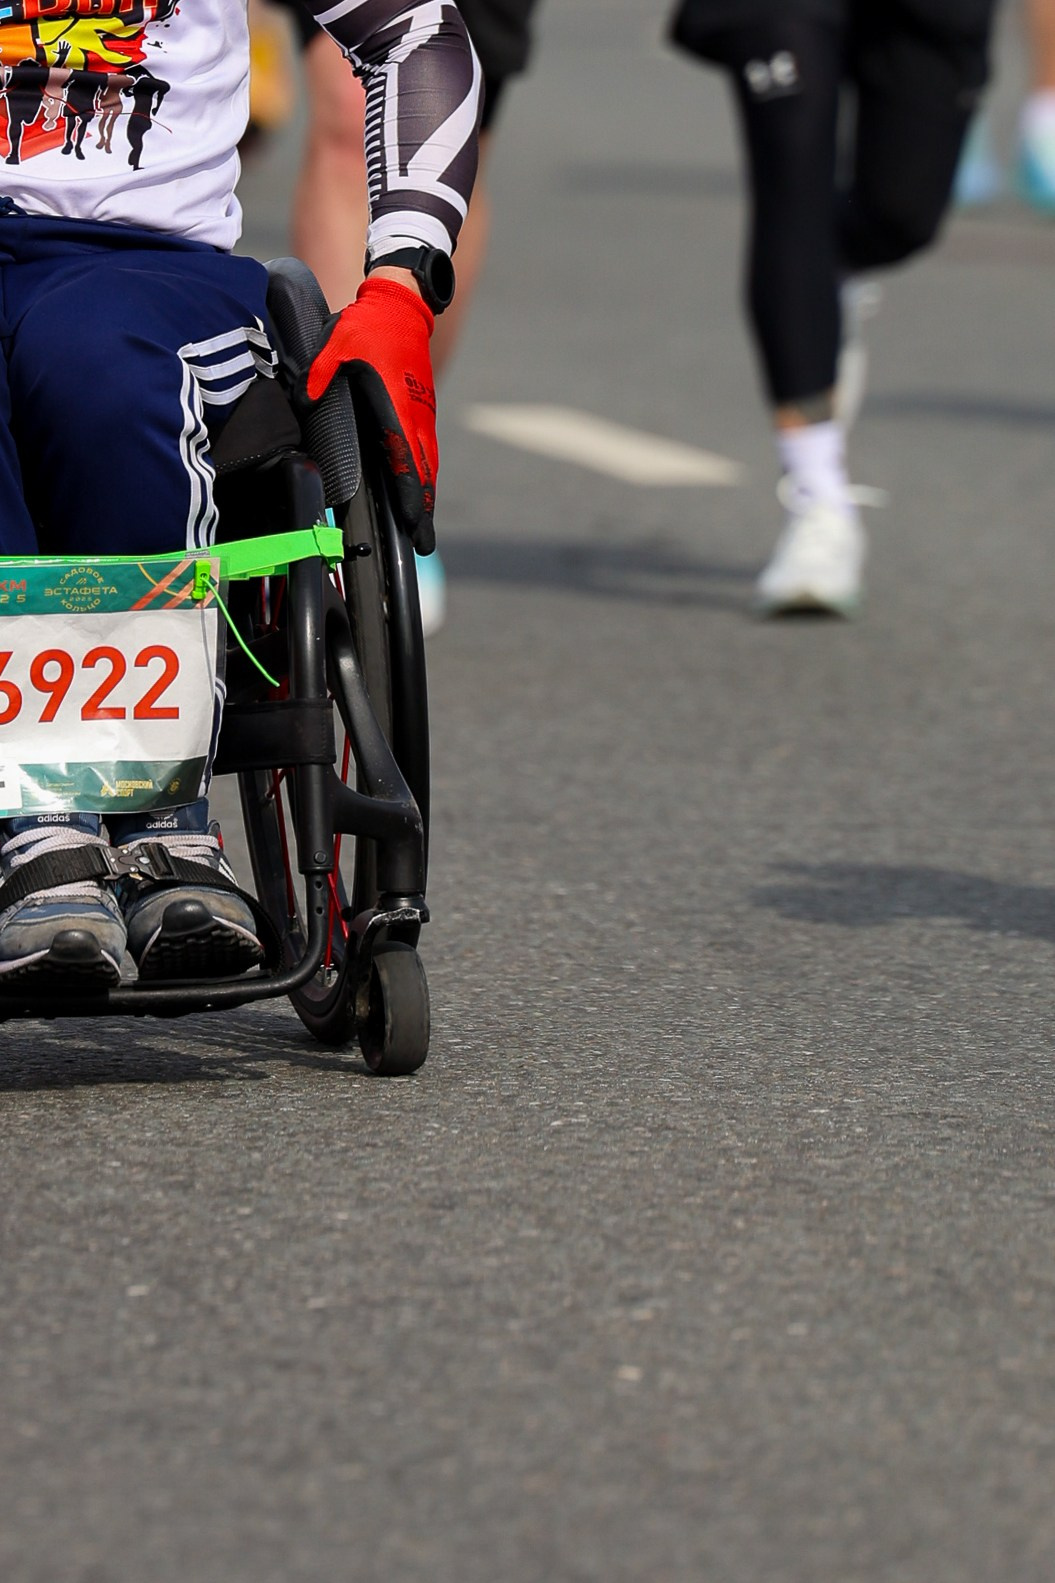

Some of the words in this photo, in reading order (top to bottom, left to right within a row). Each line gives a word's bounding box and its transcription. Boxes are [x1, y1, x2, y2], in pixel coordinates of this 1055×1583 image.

[43, 586, 118, 597] ЭСТАФЕТА
[60, 597, 102, 612] КОЛЬЦО
[37, 811, 71, 824] adidas
[145, 819, 179, 829] adidas
